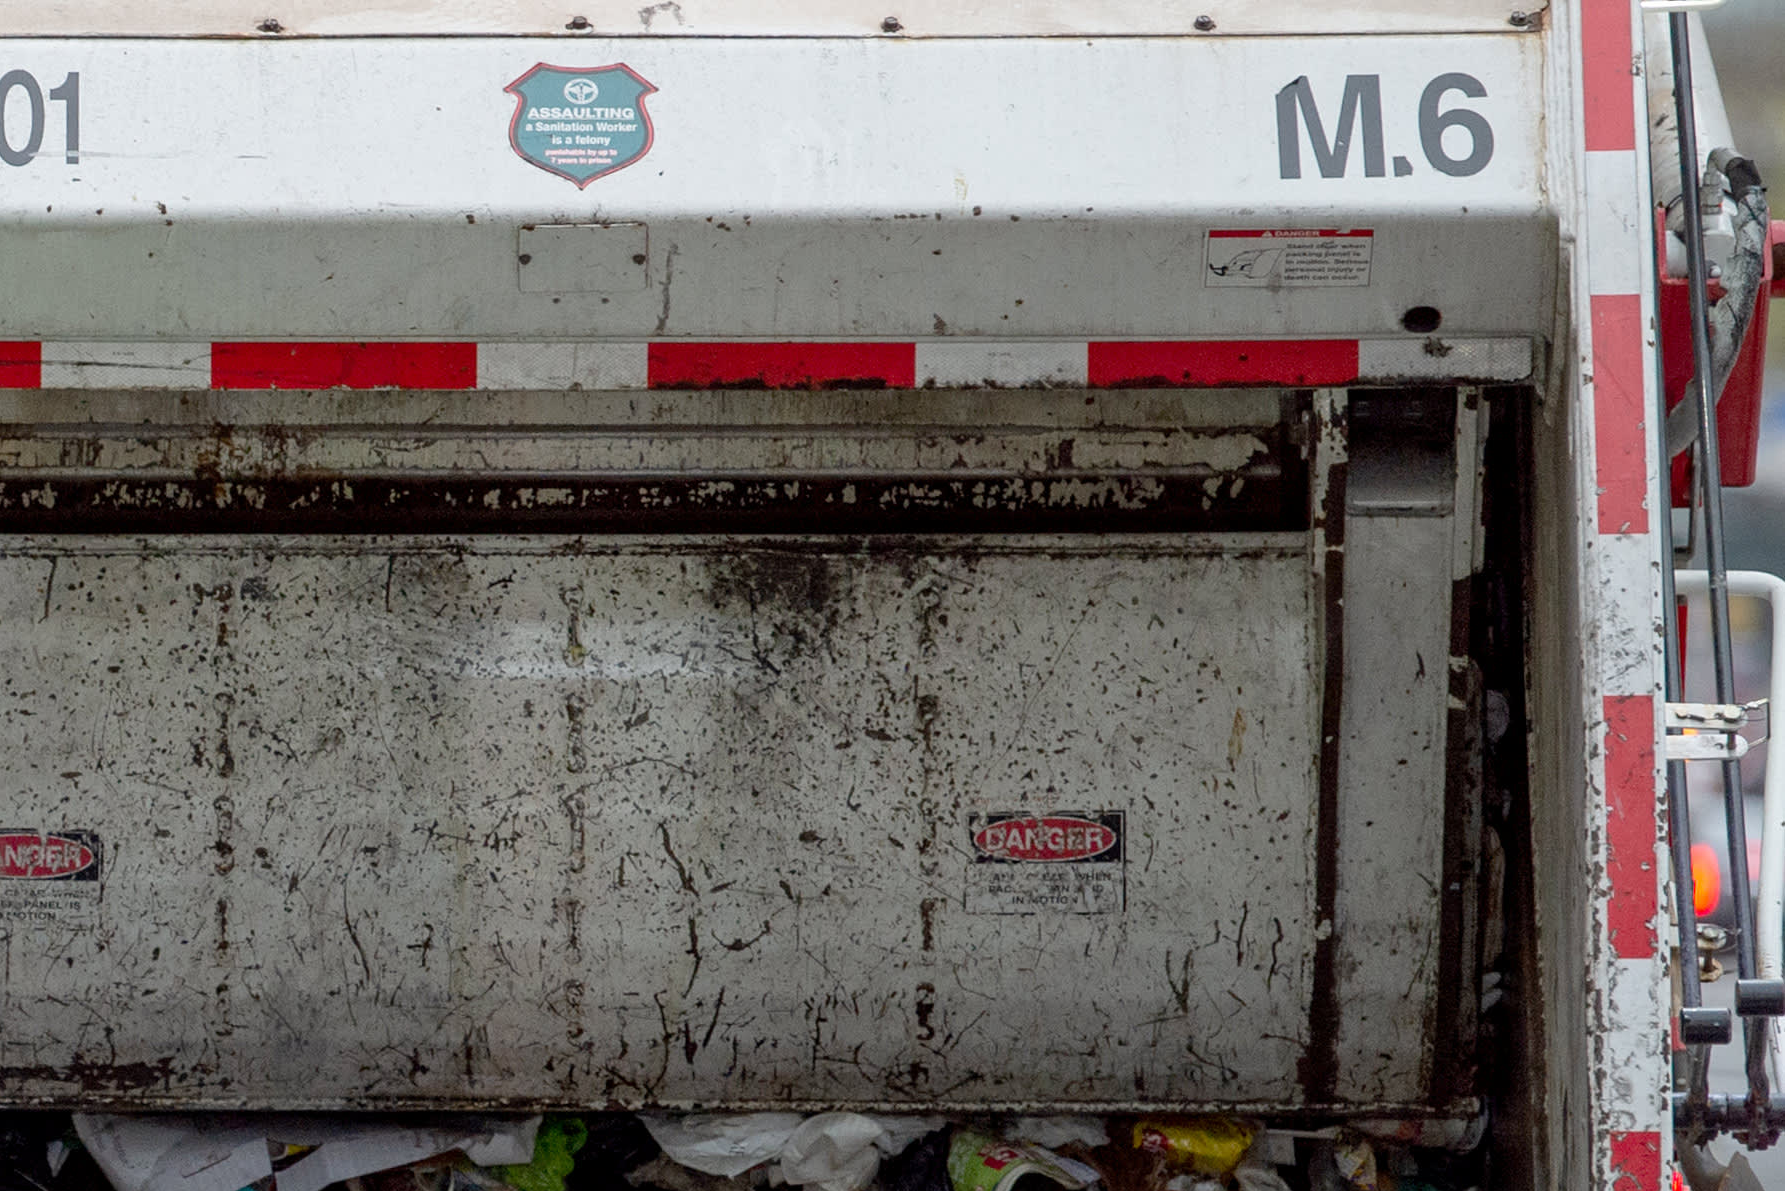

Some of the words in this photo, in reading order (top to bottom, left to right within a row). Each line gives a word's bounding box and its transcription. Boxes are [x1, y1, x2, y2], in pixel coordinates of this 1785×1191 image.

[527, 107, 635, 119] ASSAULTING
[525, 124, 533, 132] a
[535, 122, 594, 132] Sanitation
[596, 122, 638, 132] Worker
[1274, 72, 1495, 179] M.6
[552, 135, 562, 145] is
[565, 137, 572, 145] a
[575, 135, 611, 147] felony
[985, 826, 1103, 850] DANGER
